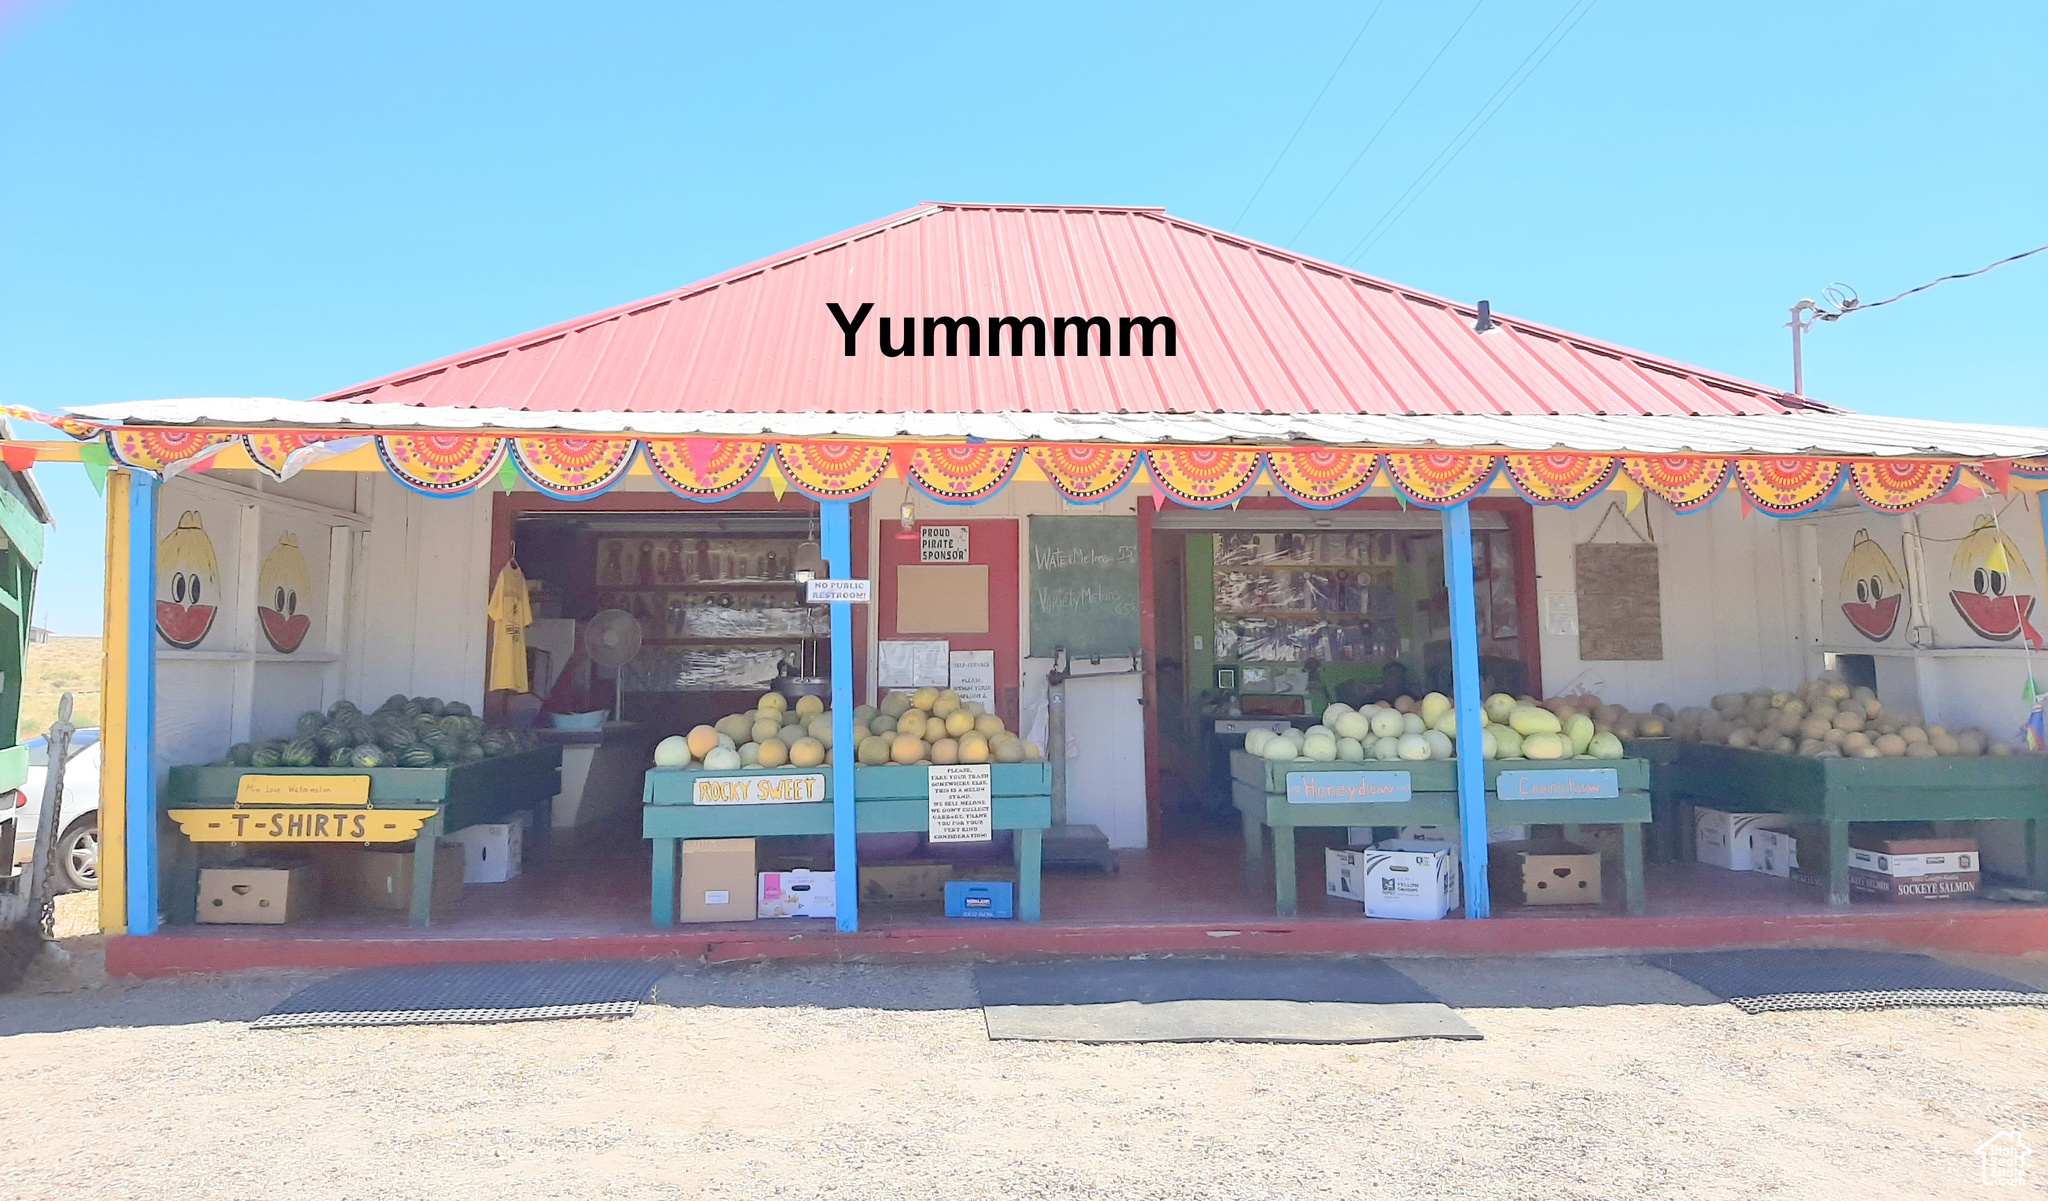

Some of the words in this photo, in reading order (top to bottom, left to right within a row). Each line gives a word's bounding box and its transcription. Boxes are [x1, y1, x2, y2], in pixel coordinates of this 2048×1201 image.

[922, 528, 950, 537] PROUD
[922, 539, 953, 548] PIRATE
[922, 550, 964, 560] SPONSOR
[831, 582, 865, 590] PUBLIC
[812, 591, 866, 599] RESTROOM!
[698, 780, 752, 802] ROCKY
[756, 776, 816, 801] SWEET
[1302, 777, 1396, 802] Honeydew
[1518, 777, 1600, 796] Crenshaw
[231, 813, 367, 838] T-SHIRTS
[1898, 882, 1937, 895] SOCKEYE
[1939, 881, 1975, 892] SALMON
